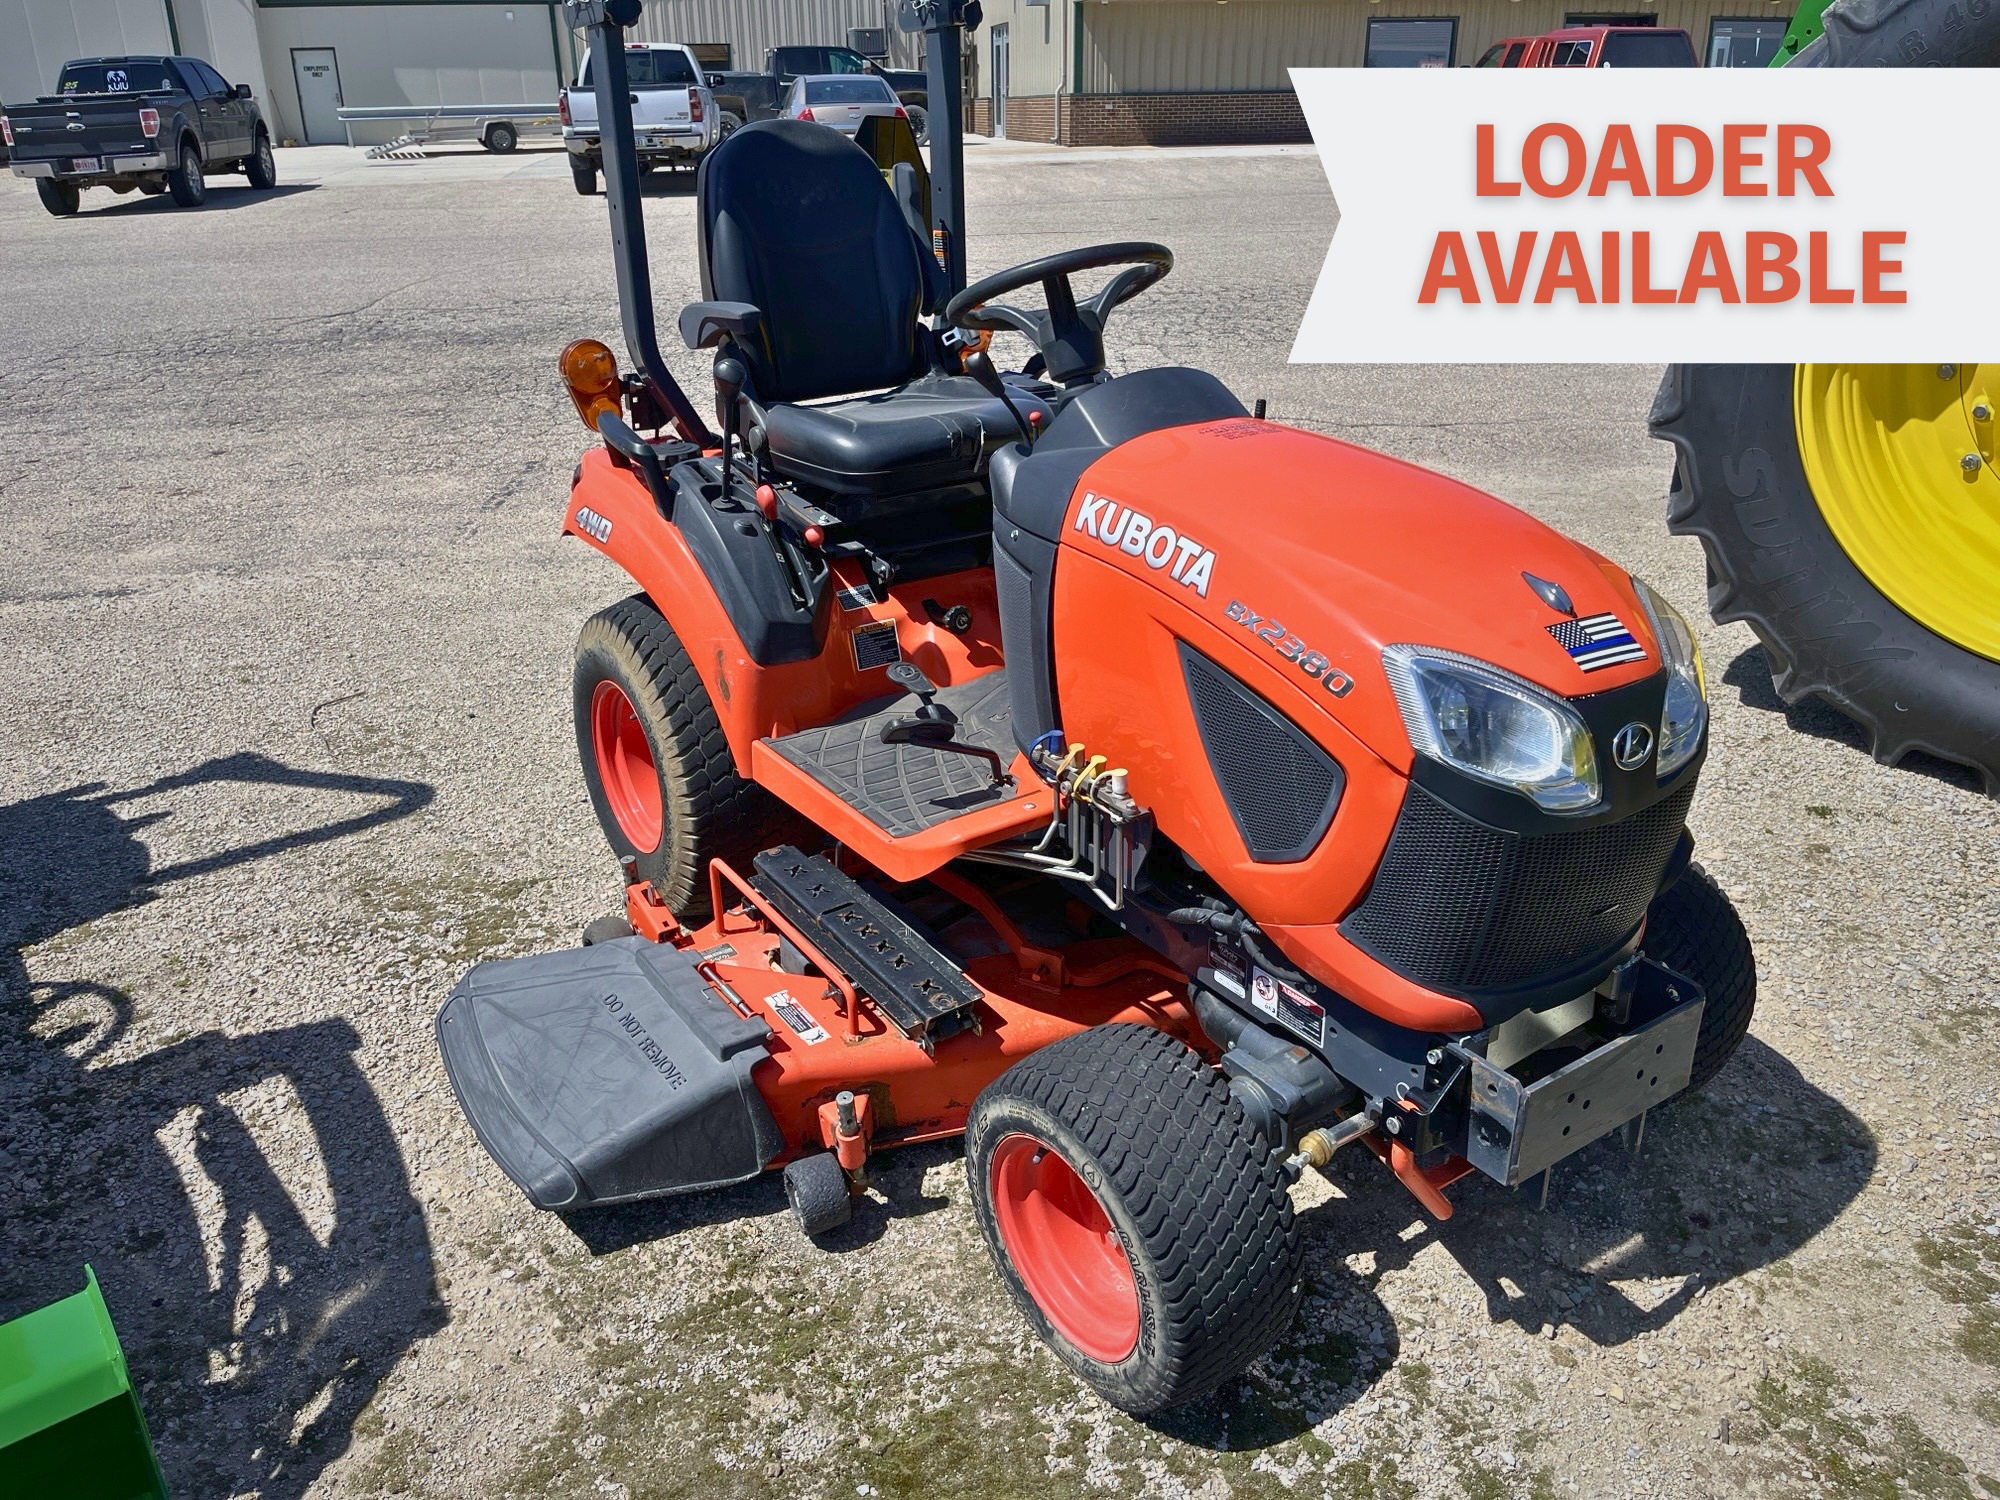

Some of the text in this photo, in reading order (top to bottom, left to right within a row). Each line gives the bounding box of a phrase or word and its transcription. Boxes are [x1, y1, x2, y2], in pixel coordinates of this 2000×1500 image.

[575, 505, 614, 545] 4WD
[1074, 493, 1217, 599] KUBOTA
[1223, 599, 1355, 699] BX2380
[602, 993, 688, 1090] DO NOT REMOVE
[1286, 988, 1312, 1008] DANGER
